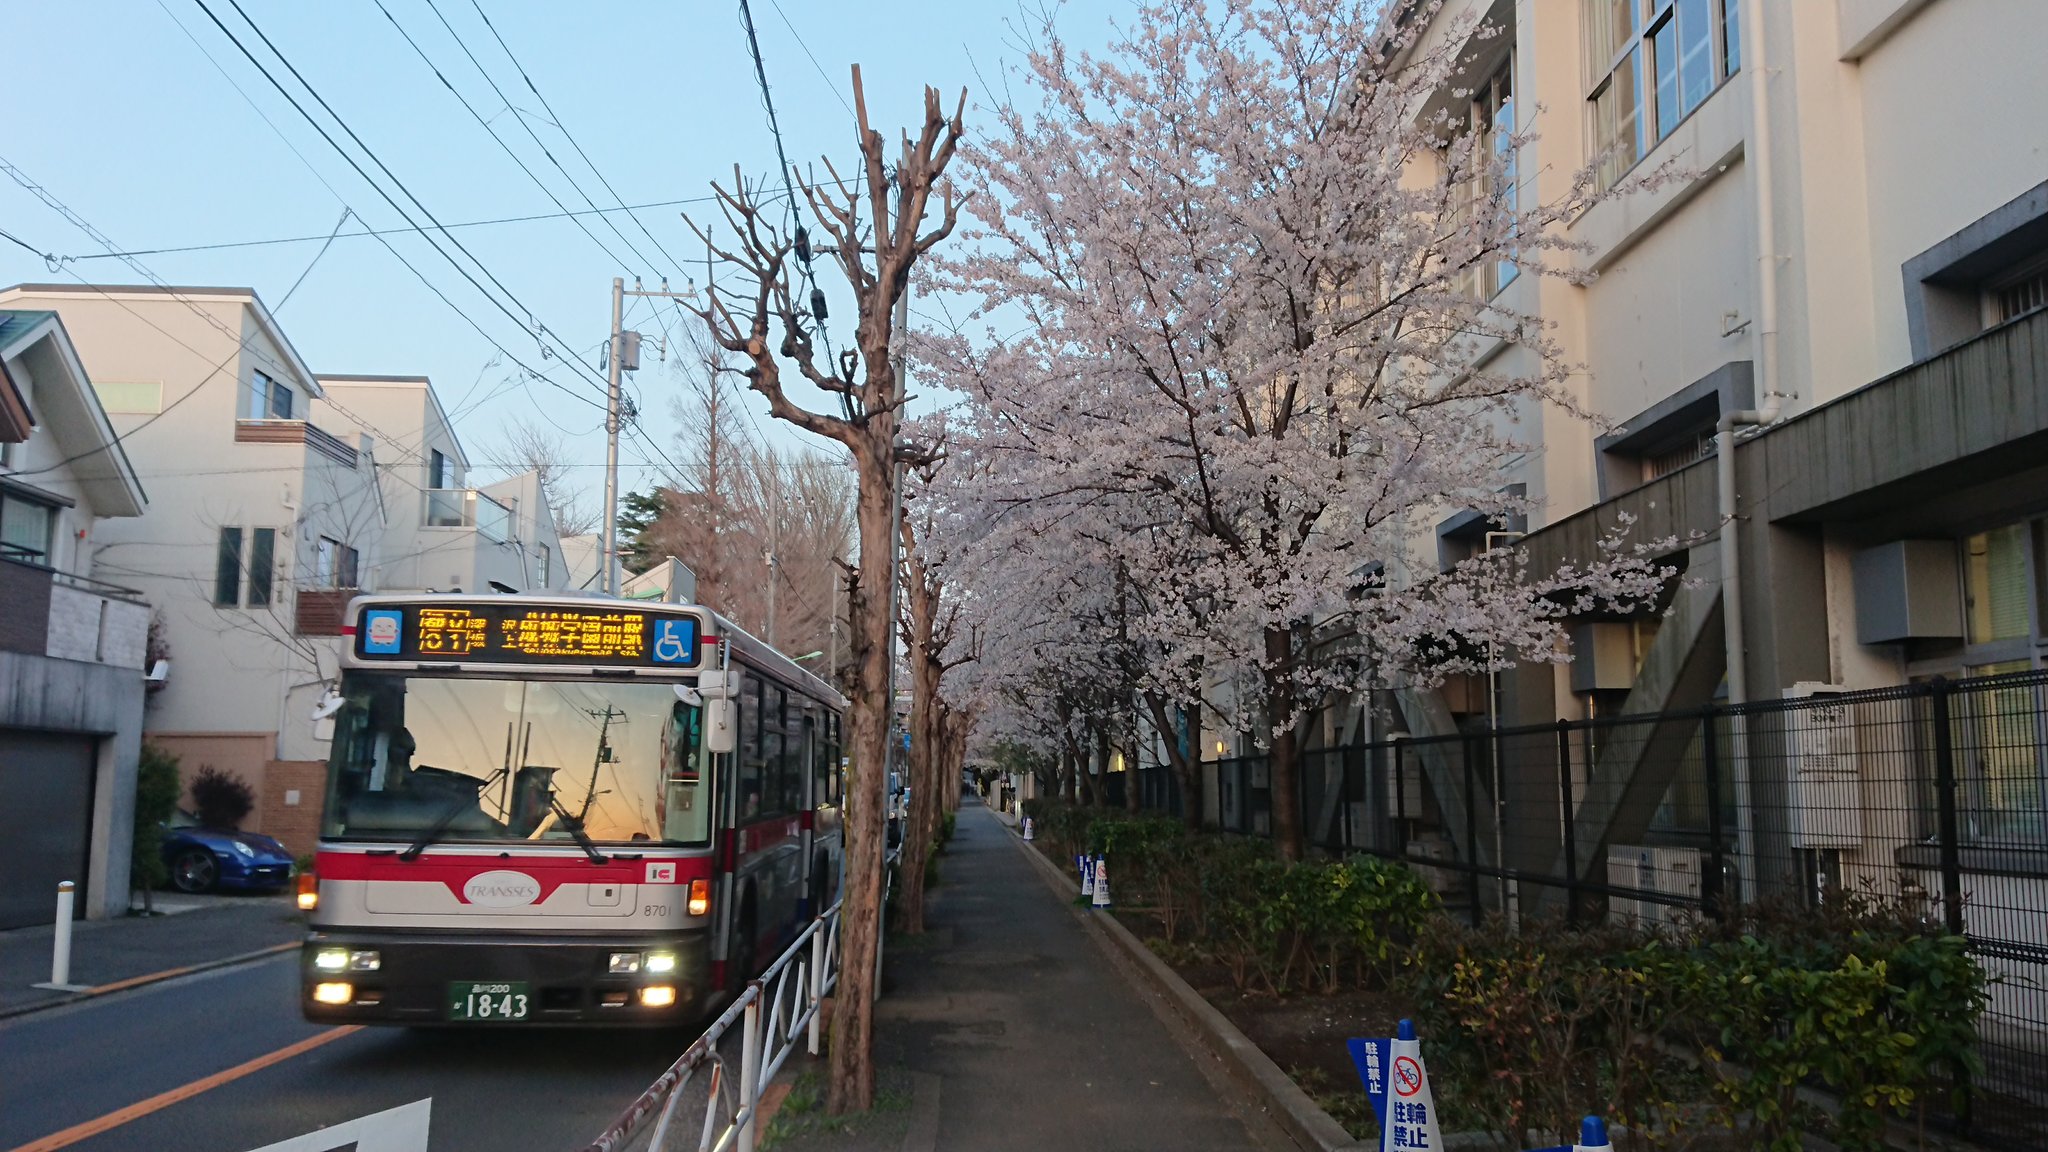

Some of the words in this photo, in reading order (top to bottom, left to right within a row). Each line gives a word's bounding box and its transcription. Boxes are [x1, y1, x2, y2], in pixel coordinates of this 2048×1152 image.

[425, 632, 463, 650] 01
[469, 885, 535, 898] TRANSSES
[643, 904, 672, 917] 8701
[466, 993, 528, 1018] 18-43
[1364, 1041, 1383, 1095] 駐輪禁止
[1393, 1101, 1428, 1126] 駐輪
[1393, 1125, 1430, 1149] 禁止
